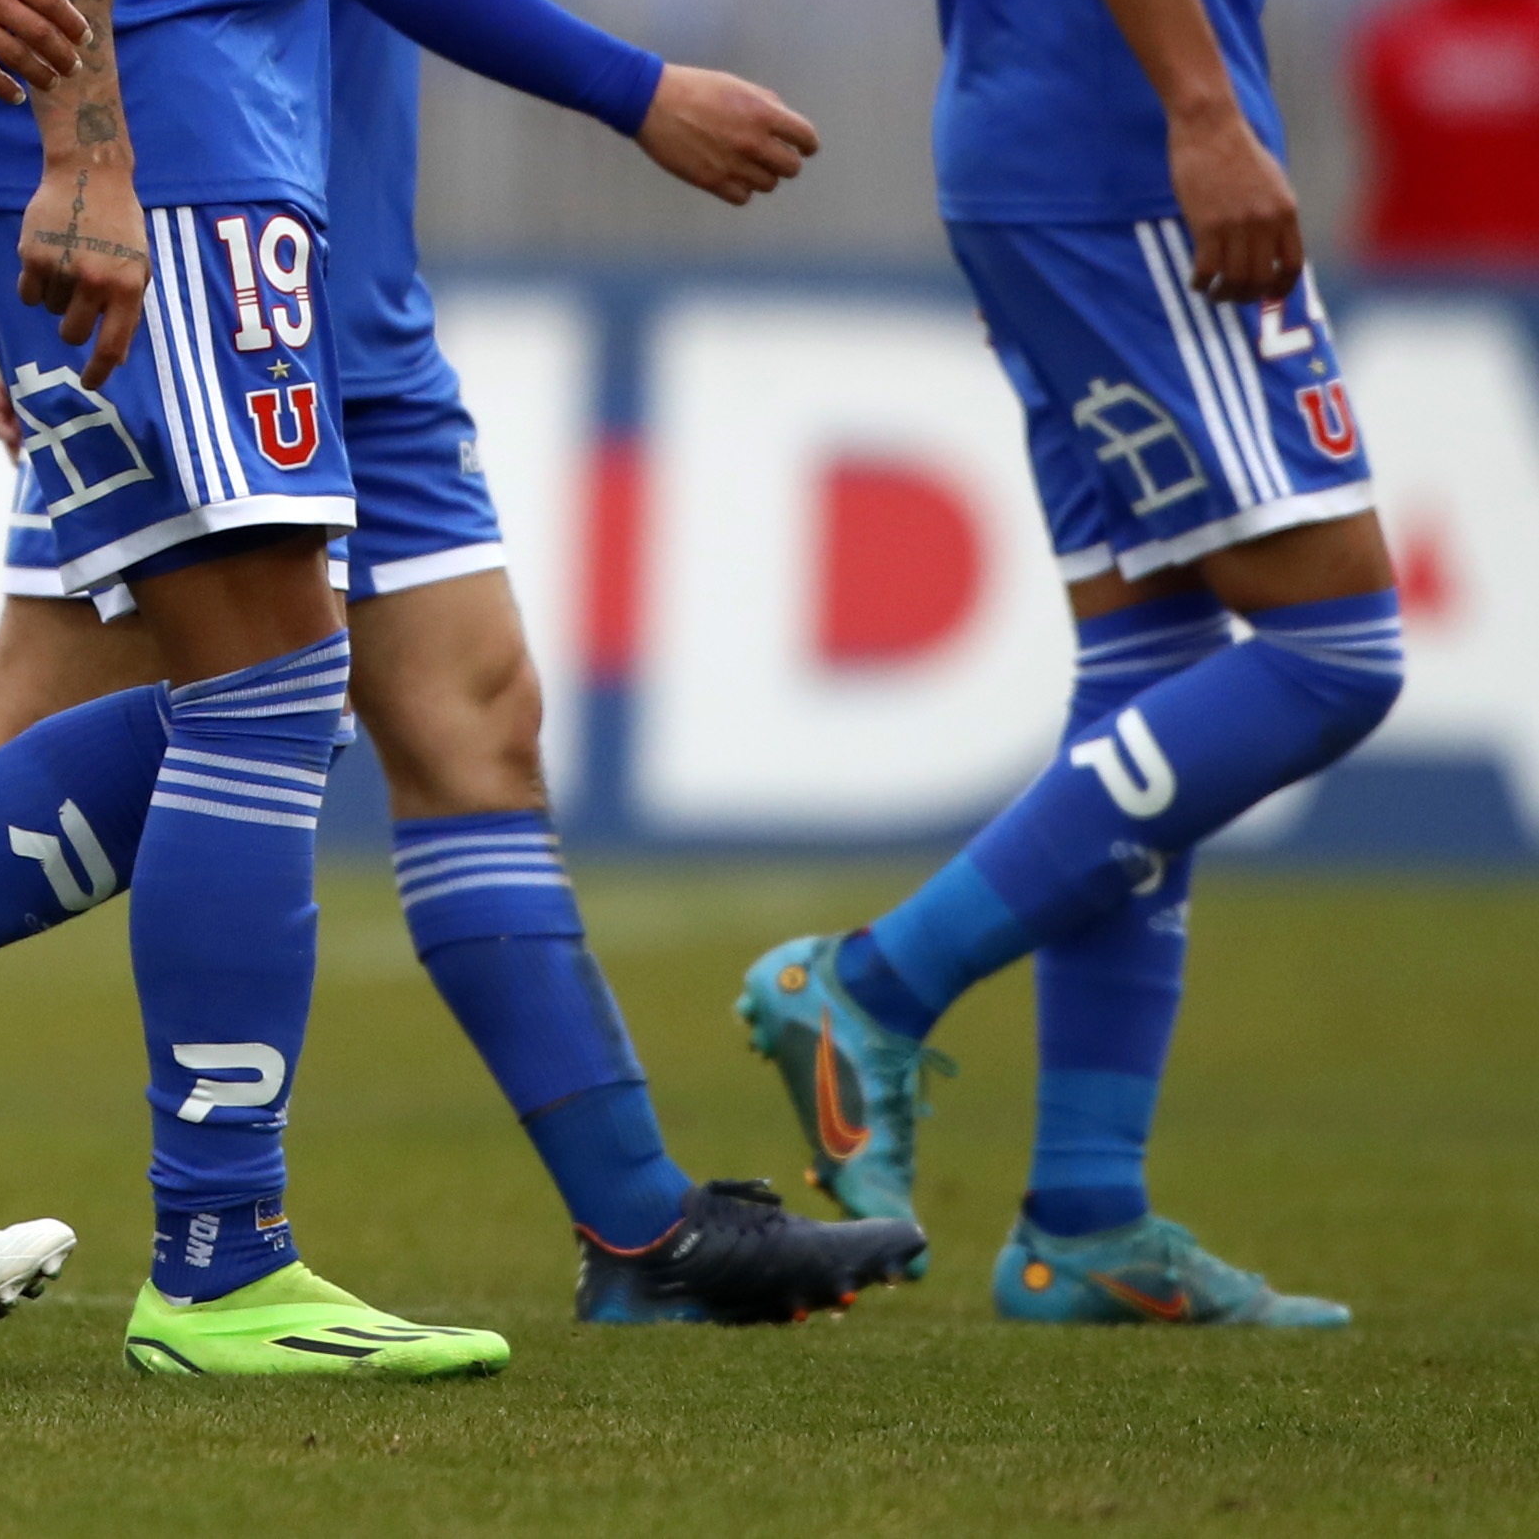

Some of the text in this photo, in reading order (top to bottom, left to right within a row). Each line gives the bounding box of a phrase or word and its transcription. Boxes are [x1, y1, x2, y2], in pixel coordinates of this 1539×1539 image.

[216, 214, 314, 352] 19
[246, 381, 320, 472] U
[1295, 378, 1358, 460] U
